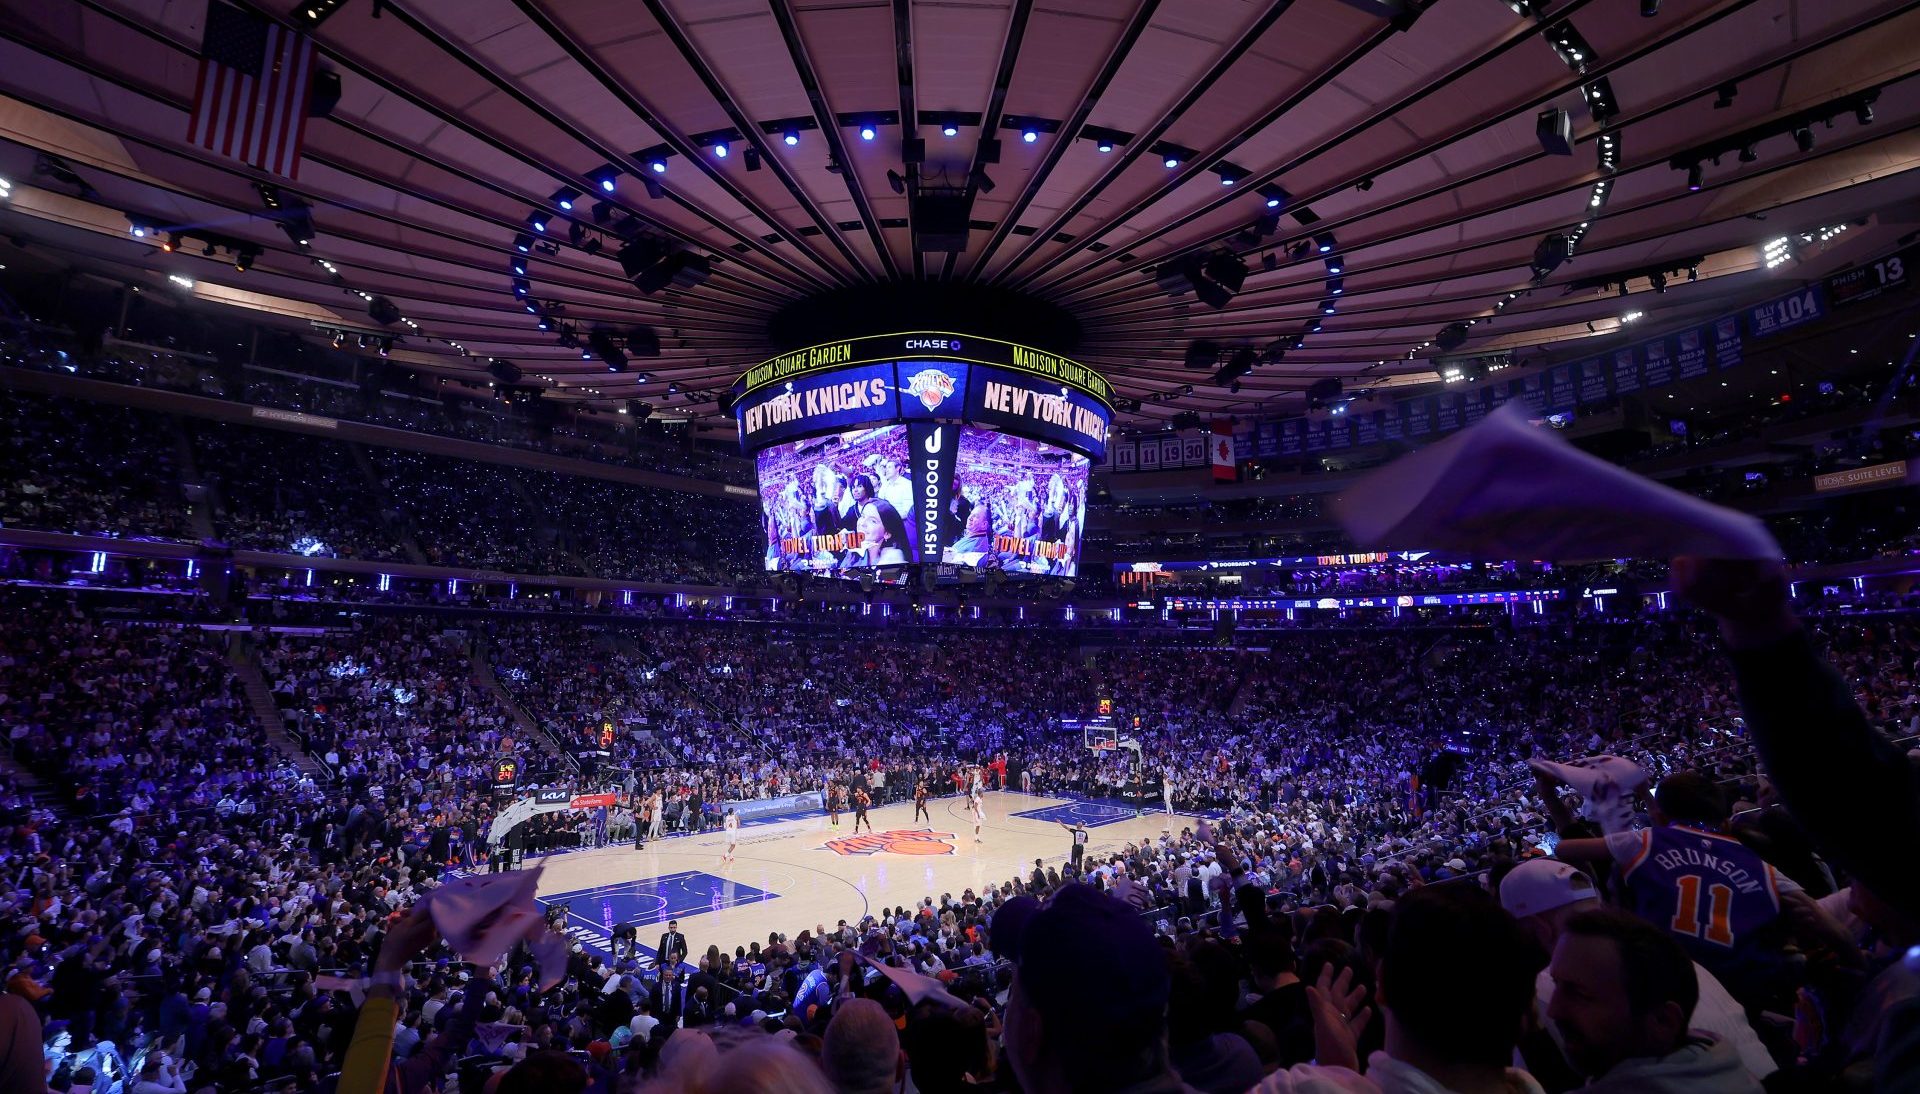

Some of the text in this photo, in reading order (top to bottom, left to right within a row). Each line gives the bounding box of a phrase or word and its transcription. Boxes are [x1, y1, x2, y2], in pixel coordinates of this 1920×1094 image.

[1831, 269, 1866, 288] PHISH
[1873, 257, 1905, 285] 13
[1755, 303, 1776, 320] BILLY
[1777, 291, 1818, 324] 104
[906, 339, 948, 349] CHASE
[747, 344, 851, 389] MADISON SQUARE GARDEN
[1013, 346, 1106, 397] MADISON SQUARE GARDEN
[745, 378, 887, 435] NEW YORK KNICKS
[984, 381, 1105, 443] NEW YORK KNICKS
[1119, 450, 1132, 464] 11
[1143, 449, 1156, 463] 11
[1165, 447, 1180, 461] 19
[1186, 445, 1203, 459] 30
[1847, 471, 1874, 482] SUITE
[1875, 465, 1905, 478] LEVEL
[925, 459, 939, 555] DOORDASH
[781, 532, 866, 555] TOWEL TURN UP
[994, 534, 1031, 556] TOWEL
[1035, 540, 1057, 560] TURN
[1317, 552, 1389, 566] TOWEL TURN UP
[1100, 705, 1111, 714] 24
[601, 731, 613, 746] 24
[498, 771, 512, 781] 24
[541, 791, 566, 800] KIA
[1654, 848, 1764, 894] BRUNSON
[1670, 874, 1735, 949] 11
